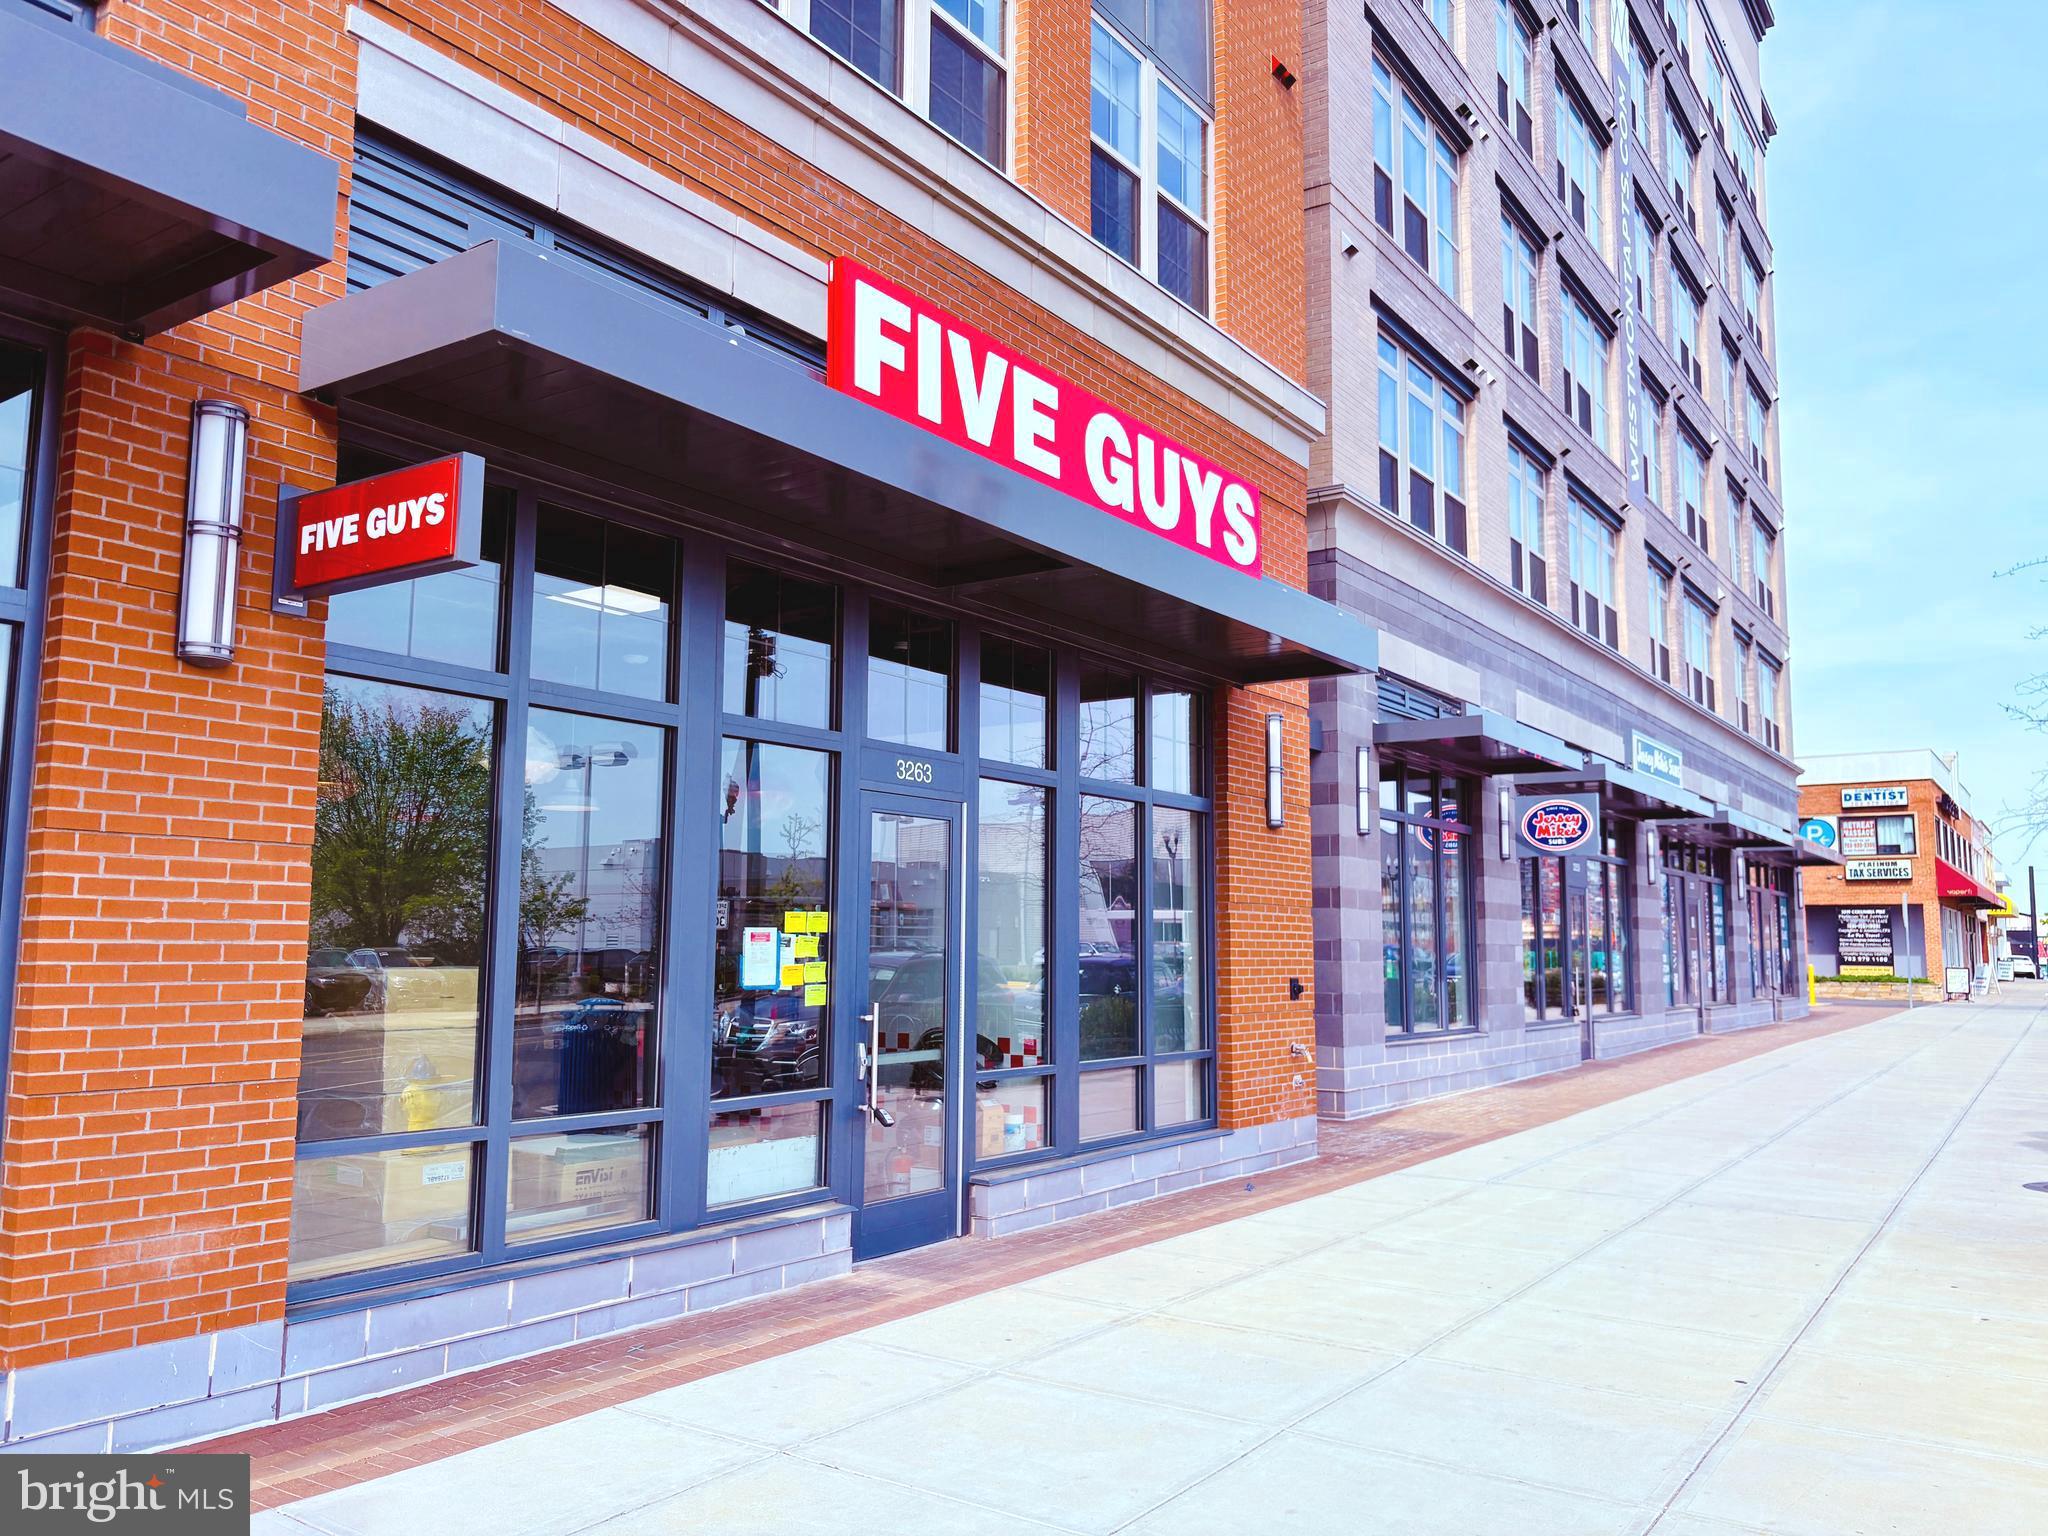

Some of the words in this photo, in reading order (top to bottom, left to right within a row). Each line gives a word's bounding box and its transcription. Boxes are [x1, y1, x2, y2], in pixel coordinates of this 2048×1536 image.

[1617, 75, 1640, 482] WESTMONTAPTS.COM
[854, 278, 1061, 480] FIVE
[1085, 412, 1257, 567] GUYS
[300, 513, 360, 555] FIVE
[366, 492, 446, 539] GUYS
[896, 759, 932, 784] 3263
[1843, 791, 1905, 802] DENTIST
[1532, 810, 1581, 827] Jersey
[1849, 868, 1865, 878] TAX
[1867, 867, 1909, 878] SERVICES
[1858, 860, 1898, 868] PLATINUM
